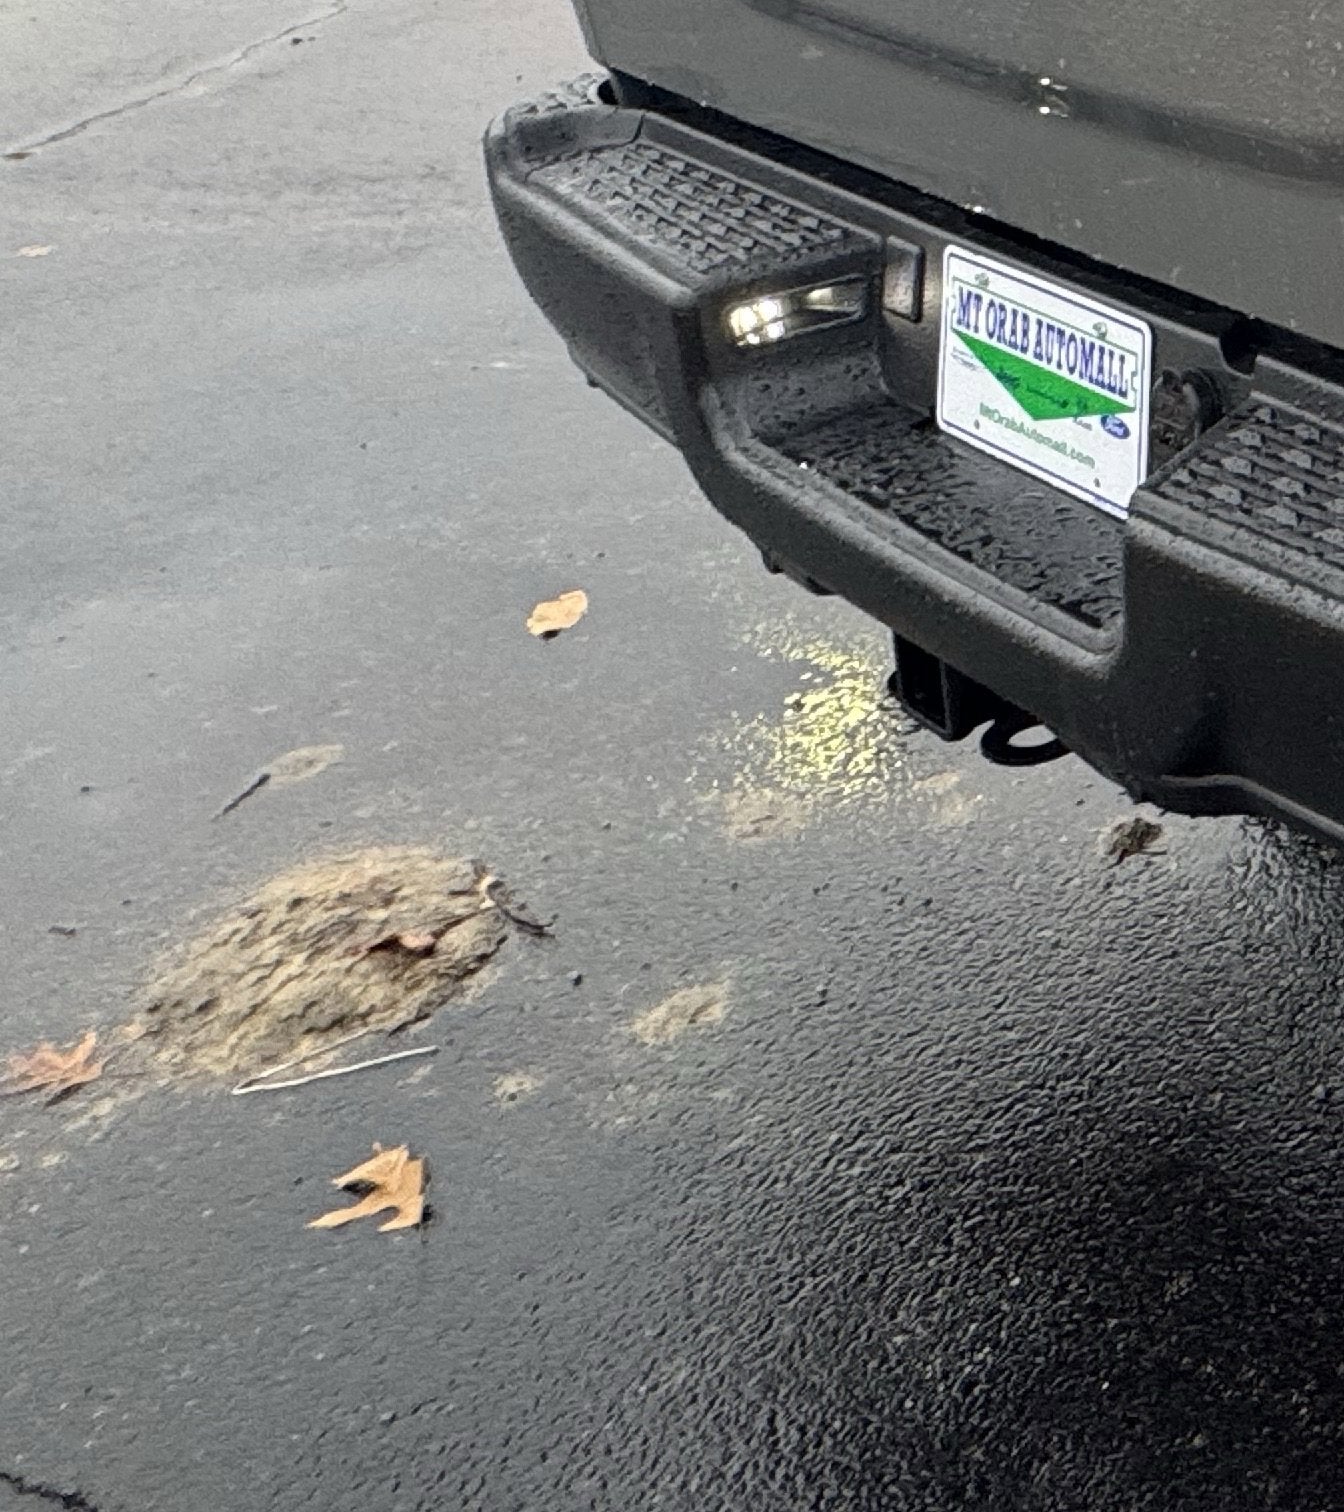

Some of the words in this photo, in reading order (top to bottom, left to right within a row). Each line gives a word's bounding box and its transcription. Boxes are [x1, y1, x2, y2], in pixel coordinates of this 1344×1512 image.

[956, 286, 983, 334] MT
[985, 298, 1030, 354] ORAB
[1033, 318, 1129, 399] AUTOMALL
